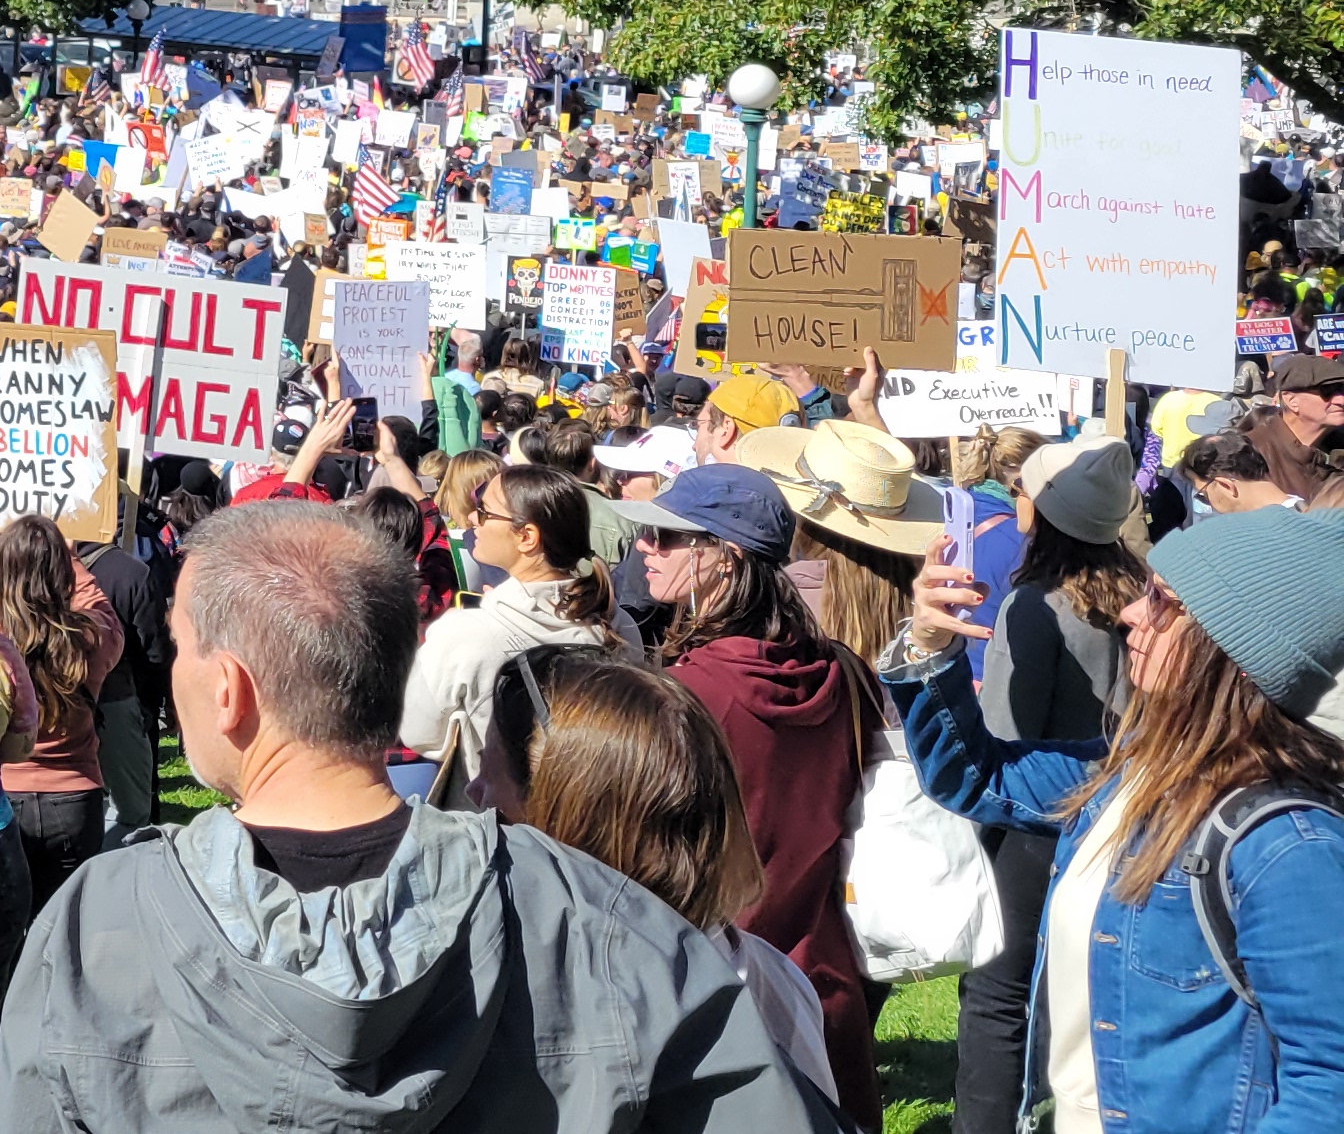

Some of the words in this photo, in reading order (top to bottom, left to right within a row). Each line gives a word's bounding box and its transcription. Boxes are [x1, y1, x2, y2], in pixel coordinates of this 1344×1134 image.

[1078, 65, 1129, 86] those
[1137, 67, 1154, 89] in
[1166, 73, 1213, 93] need
[1098, 198, 1164, 223] against
[1174, 199, 1216, 221] hate
[113, 239, 130, 249] LOVE
[443, 263, 467, 271] THAT
[749, 245, 849, 279] CLEAN
[1086, 253, 1130, 275] with
[1140, 254, 1217, 284] empathy
[549, 266, 612, 283] DONNY'S
[344, 283, 412, 302] PEACEFUL
[451, 290, 472, 298] LOOK
[547, 282, 567, 294] TOP
[570, 285, 614, 297] MOTIVES
[509, 293, 543, 306] PENDEJO
[550, 296, 586, 305] GREED
[22, 271, 103, 329] NO
[120, 284, 282, 360] CULT
[343, 306, 407, 325] PROTEST
[550, 306, 595, 316] CONCEIT
[546, 315, 610, 327] DISTRACTION
[1317, 319, 1335, 331] ARE
[358, 329, 371, 339] IS
[377, 328, 404, 338] YOUR
[754, 315, 859, 353] HOUSE!
[1243, 327, 1283, 335] SMARTER
[1132, 329, 1196, 353] peace
[1241, 344, 1277, 352] TRUMP
[1242, 336, 1272, 345] THAN
[339, 345, 411, 362] CONSTIT
[542, 345, 561, 359] NO
[568, 348, 609, 364] KINGS
[929, 380, 1020, 401] Executive
[72, 402, 115, 423] LAW
[116, 372, 265, 450] MAGA
[959, 394, 1056, 423] Overreach!!
